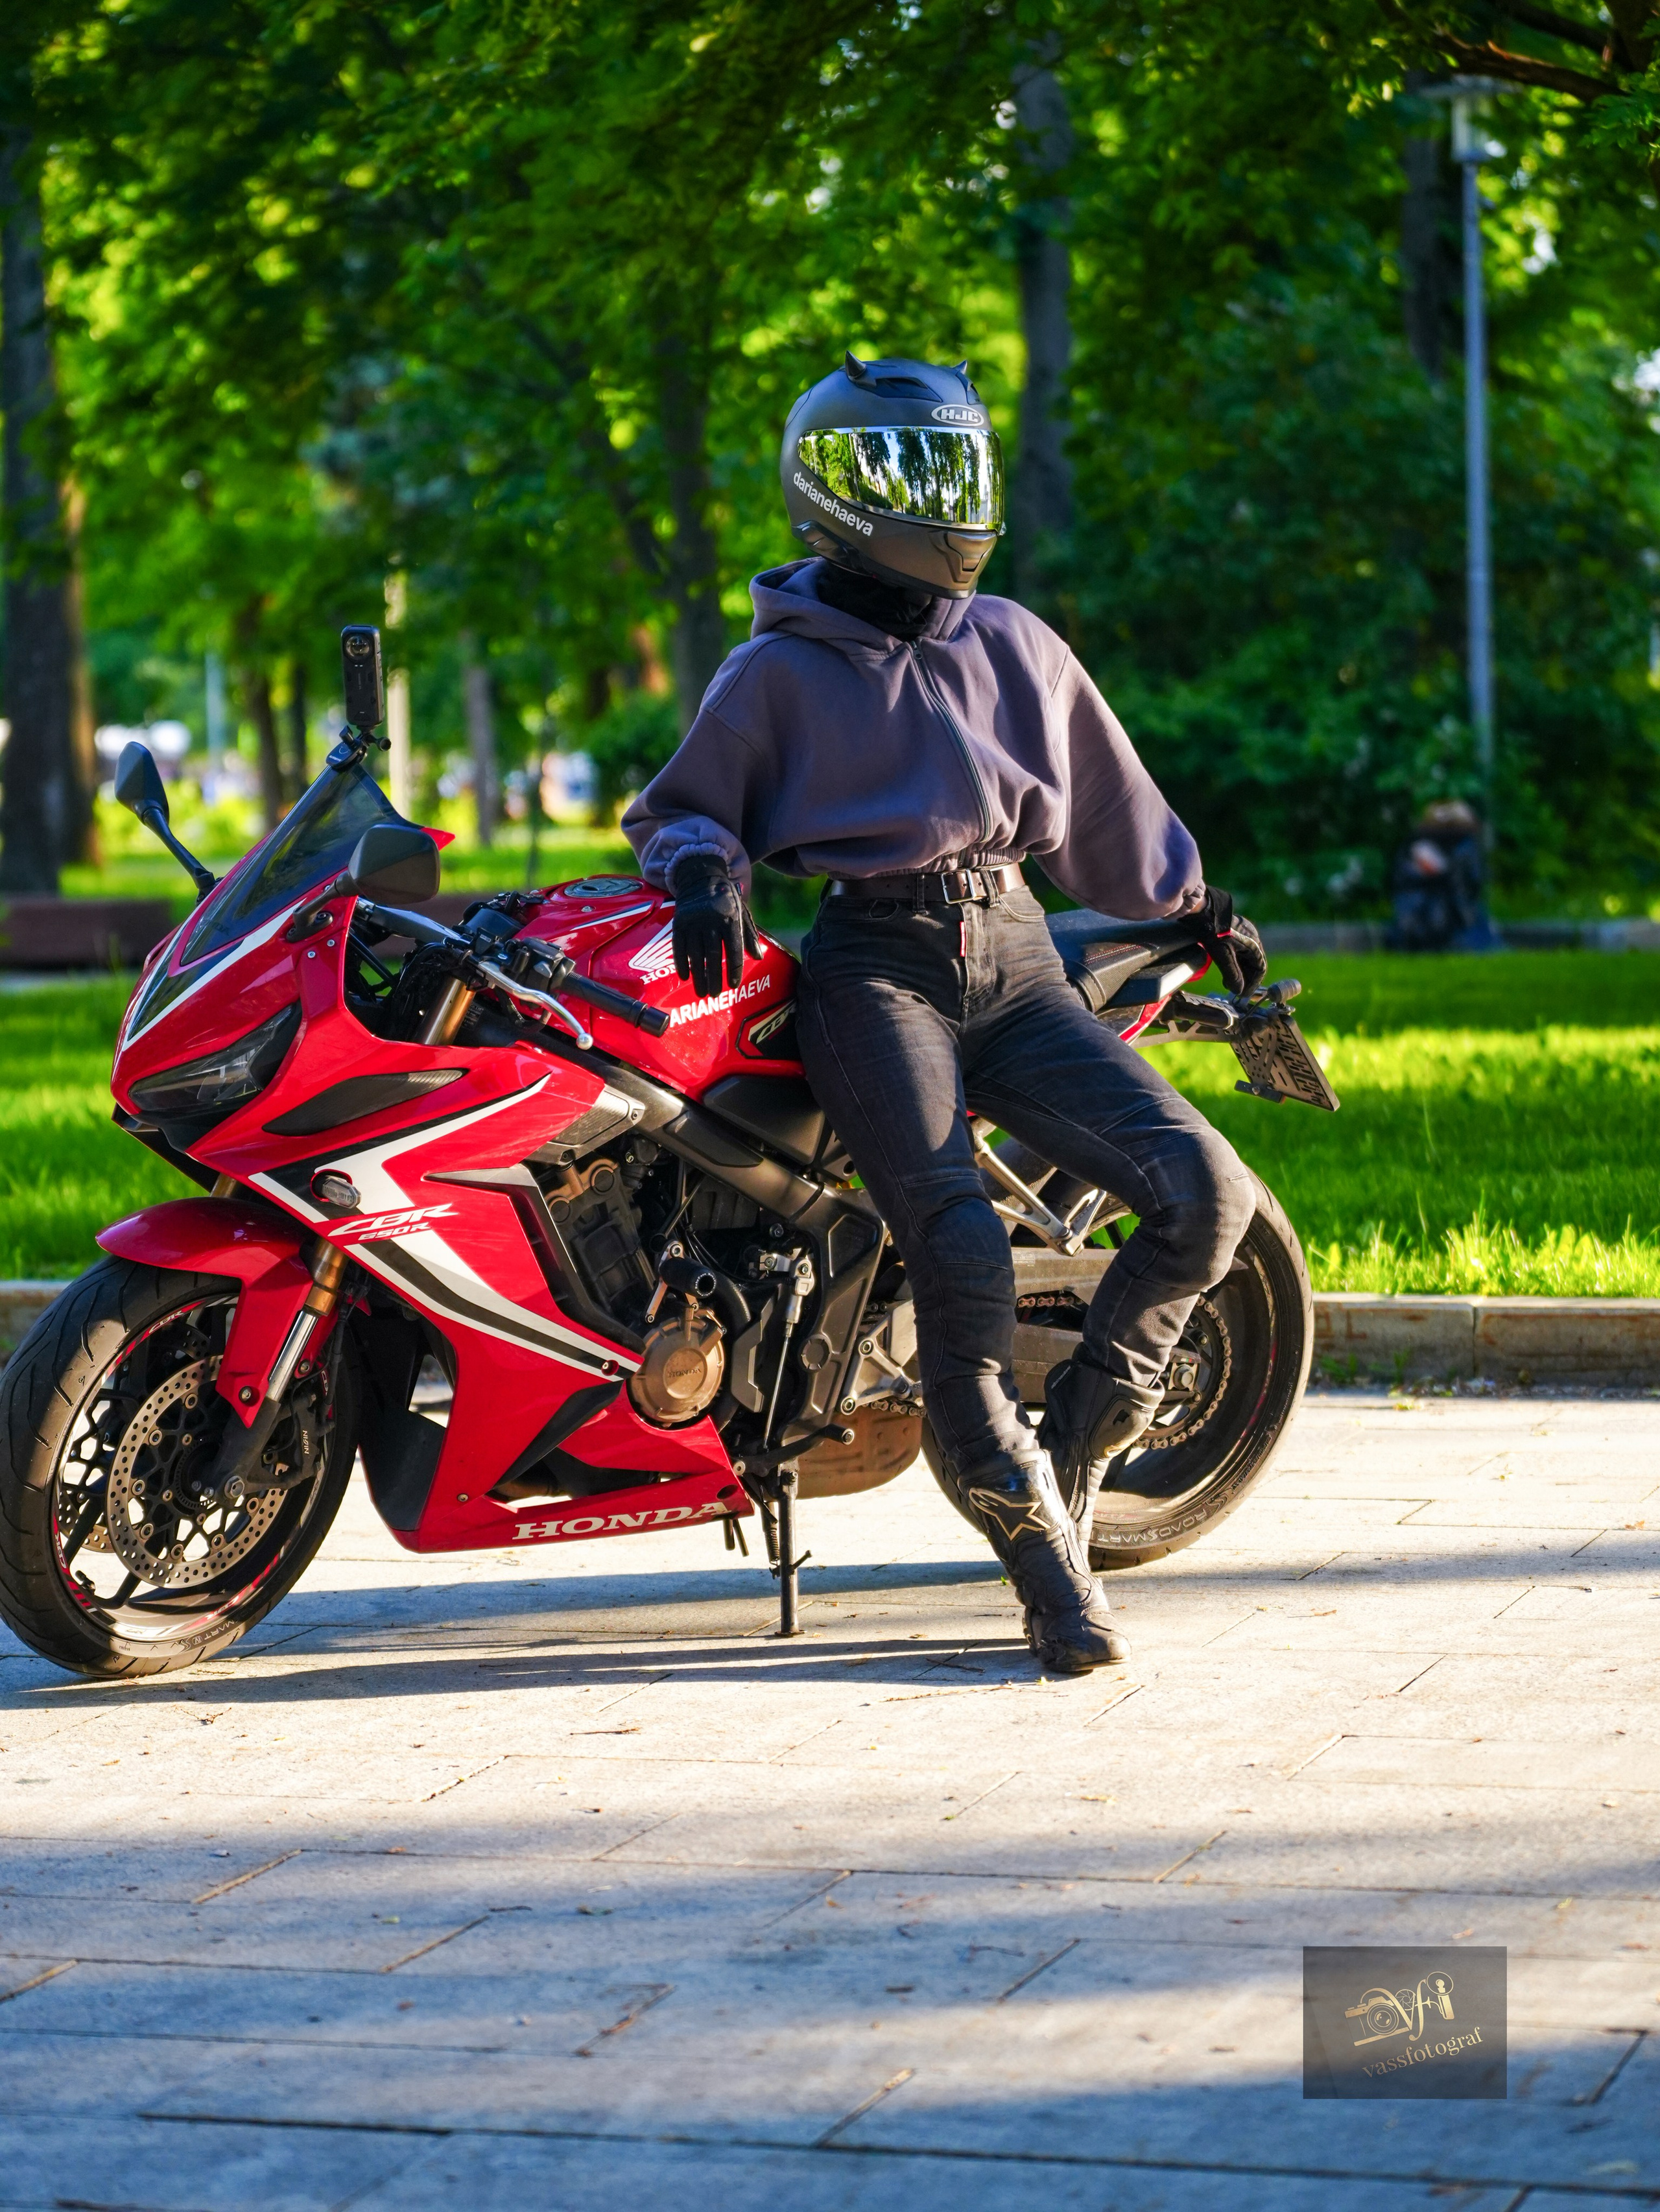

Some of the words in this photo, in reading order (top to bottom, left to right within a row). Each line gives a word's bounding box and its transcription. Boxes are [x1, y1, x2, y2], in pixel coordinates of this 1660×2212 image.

[940, 409, 978, 423] HJC
[792, 471, 873, 536] darianehaeva
[327, 1203, 459, 1237] CBR
[358, 1222, 431, 1241] 650R
[148, 1310, 184, 1334] CBR
[667, 1367, 702, 1378] HONDA
[512, 1501, 732, 1540] HONDA
[54, 1530, 67, 1569] CBR
